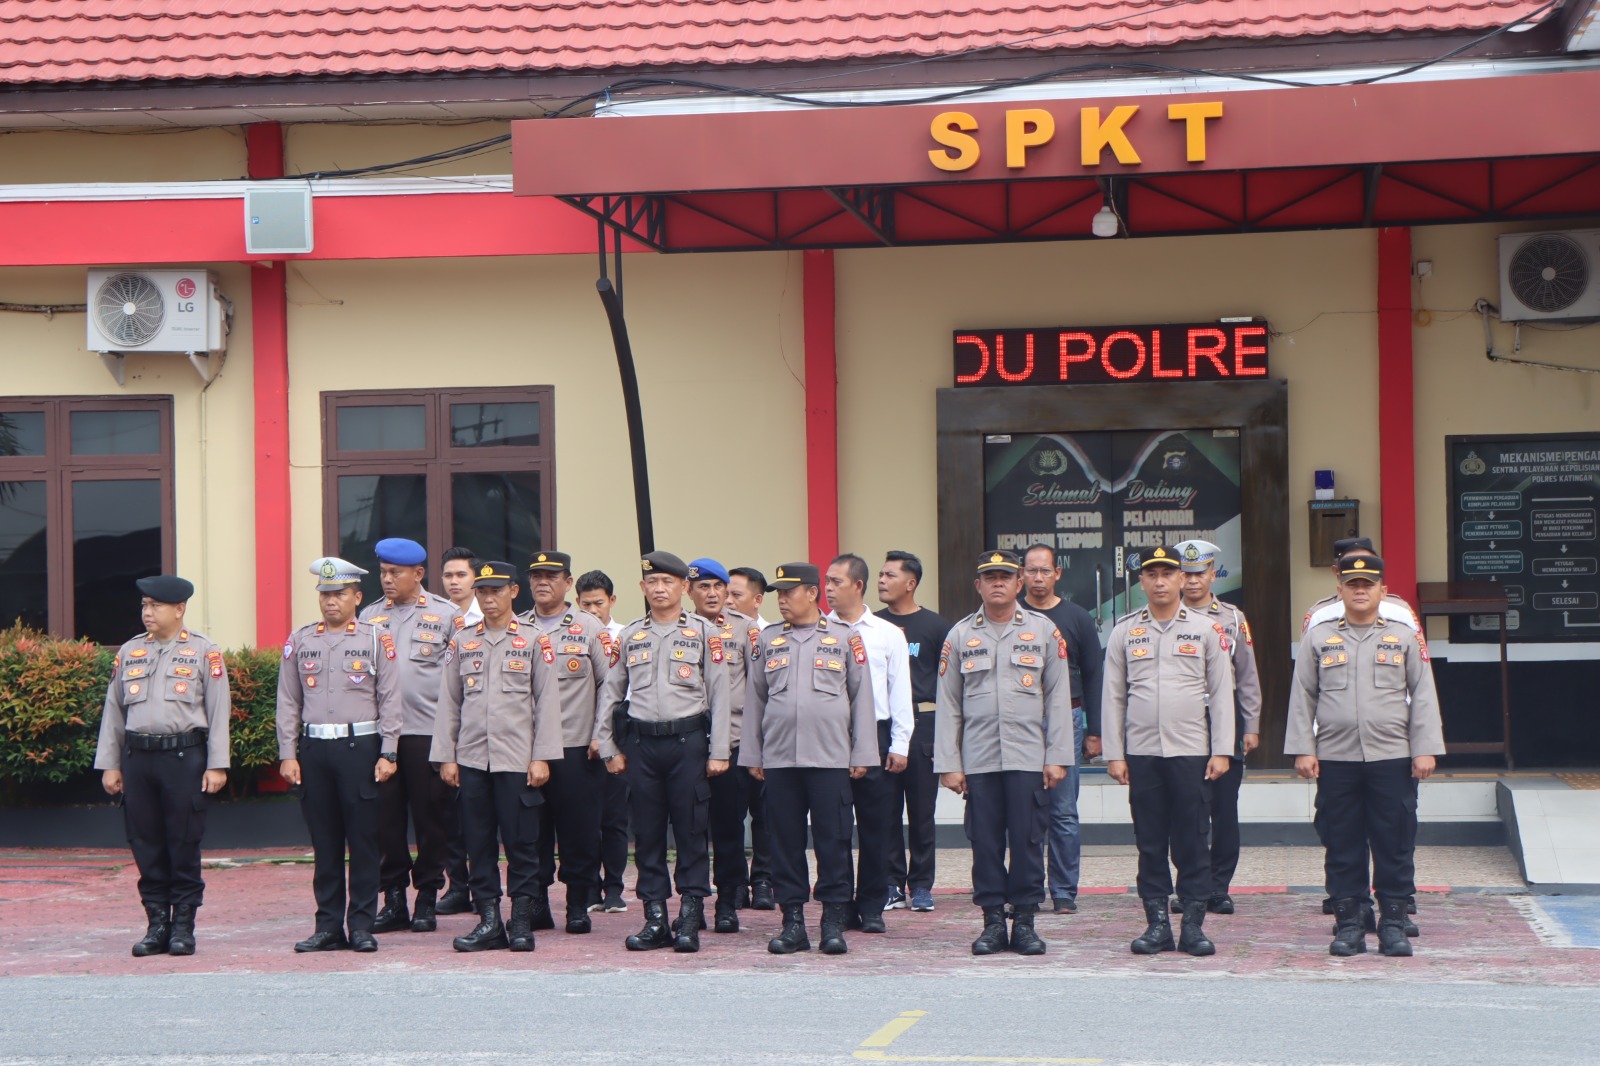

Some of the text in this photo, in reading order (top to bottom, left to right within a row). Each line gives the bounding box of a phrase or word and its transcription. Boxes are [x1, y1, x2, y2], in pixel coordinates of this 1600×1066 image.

[928, 101, 1223, 171] SPKT
[178, 302, 194, 312] LG
[1059, 327, 1266, 380] POLRE
[1500, 451, 1561, 463] MEKANISME
[1492, 463, 1600, 474] SENTRA PELAYANAN KEPOLISIAN
[1532, 474, 1593, 483] POLRES KATINGAN
[1023, 480, 1197, 508] Selamat Datang
[1056, 510, 1194, 528] SENTRA PELAYANAN
[1057, 532, 1102, 549] TERPADU
[1124, 531, 1163, 547] POLRES
[417, 622, 441, 631] POLRI
[561, 635, 586, 643] POLRI
[1128, 637, 1150, 645] HORI
[673, 640, 699, 649] POLRI
[723, 641, 737, 649] LRI
[1013, 644, 1041, 653] POLRI
[817, 646, 842, 655] POLRI
[962, 649, 988, 659] NASIR
